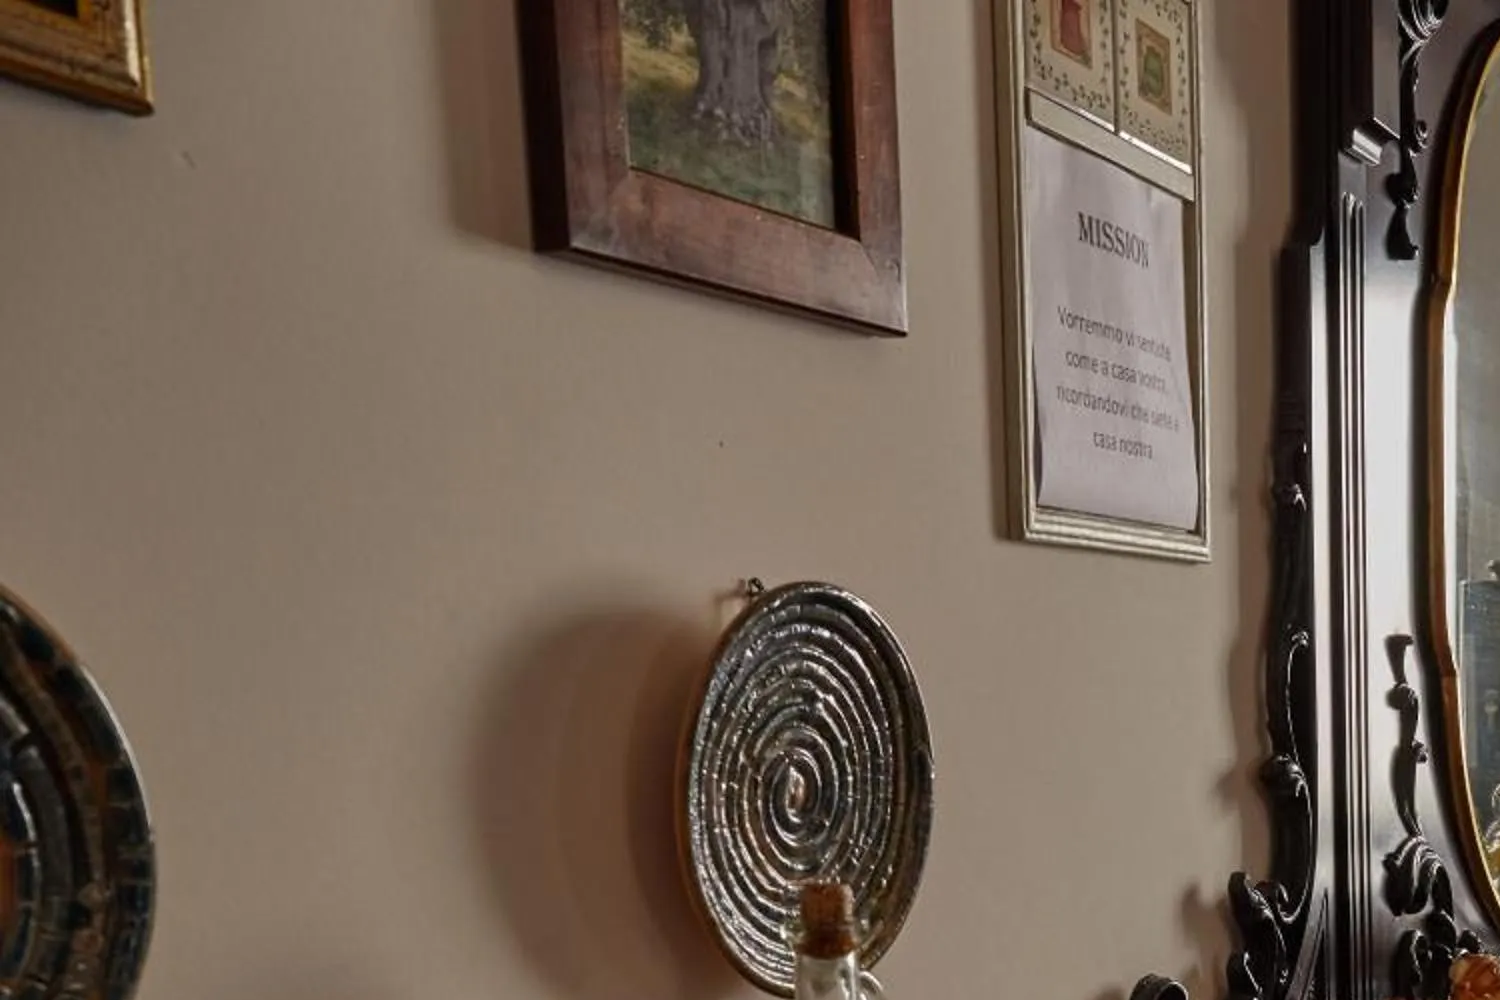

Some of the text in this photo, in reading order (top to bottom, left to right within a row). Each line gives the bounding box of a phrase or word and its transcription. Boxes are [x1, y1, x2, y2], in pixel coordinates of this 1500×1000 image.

[1077, 211, 1150, 268] MISSION
[1057, 305, 1123, 345] Vorremmo
[1125, 330, 1135, 347] vi
[1065, 351, 1099, 375] come
[1101, 360, 1109, 377] a
[1111, 363, 1137, 384] casa
[1056, 384, 1127, 417] ricordandovi
[1131, 402, 1149, 424] che
[1093, 431, 1117, 451] casa
